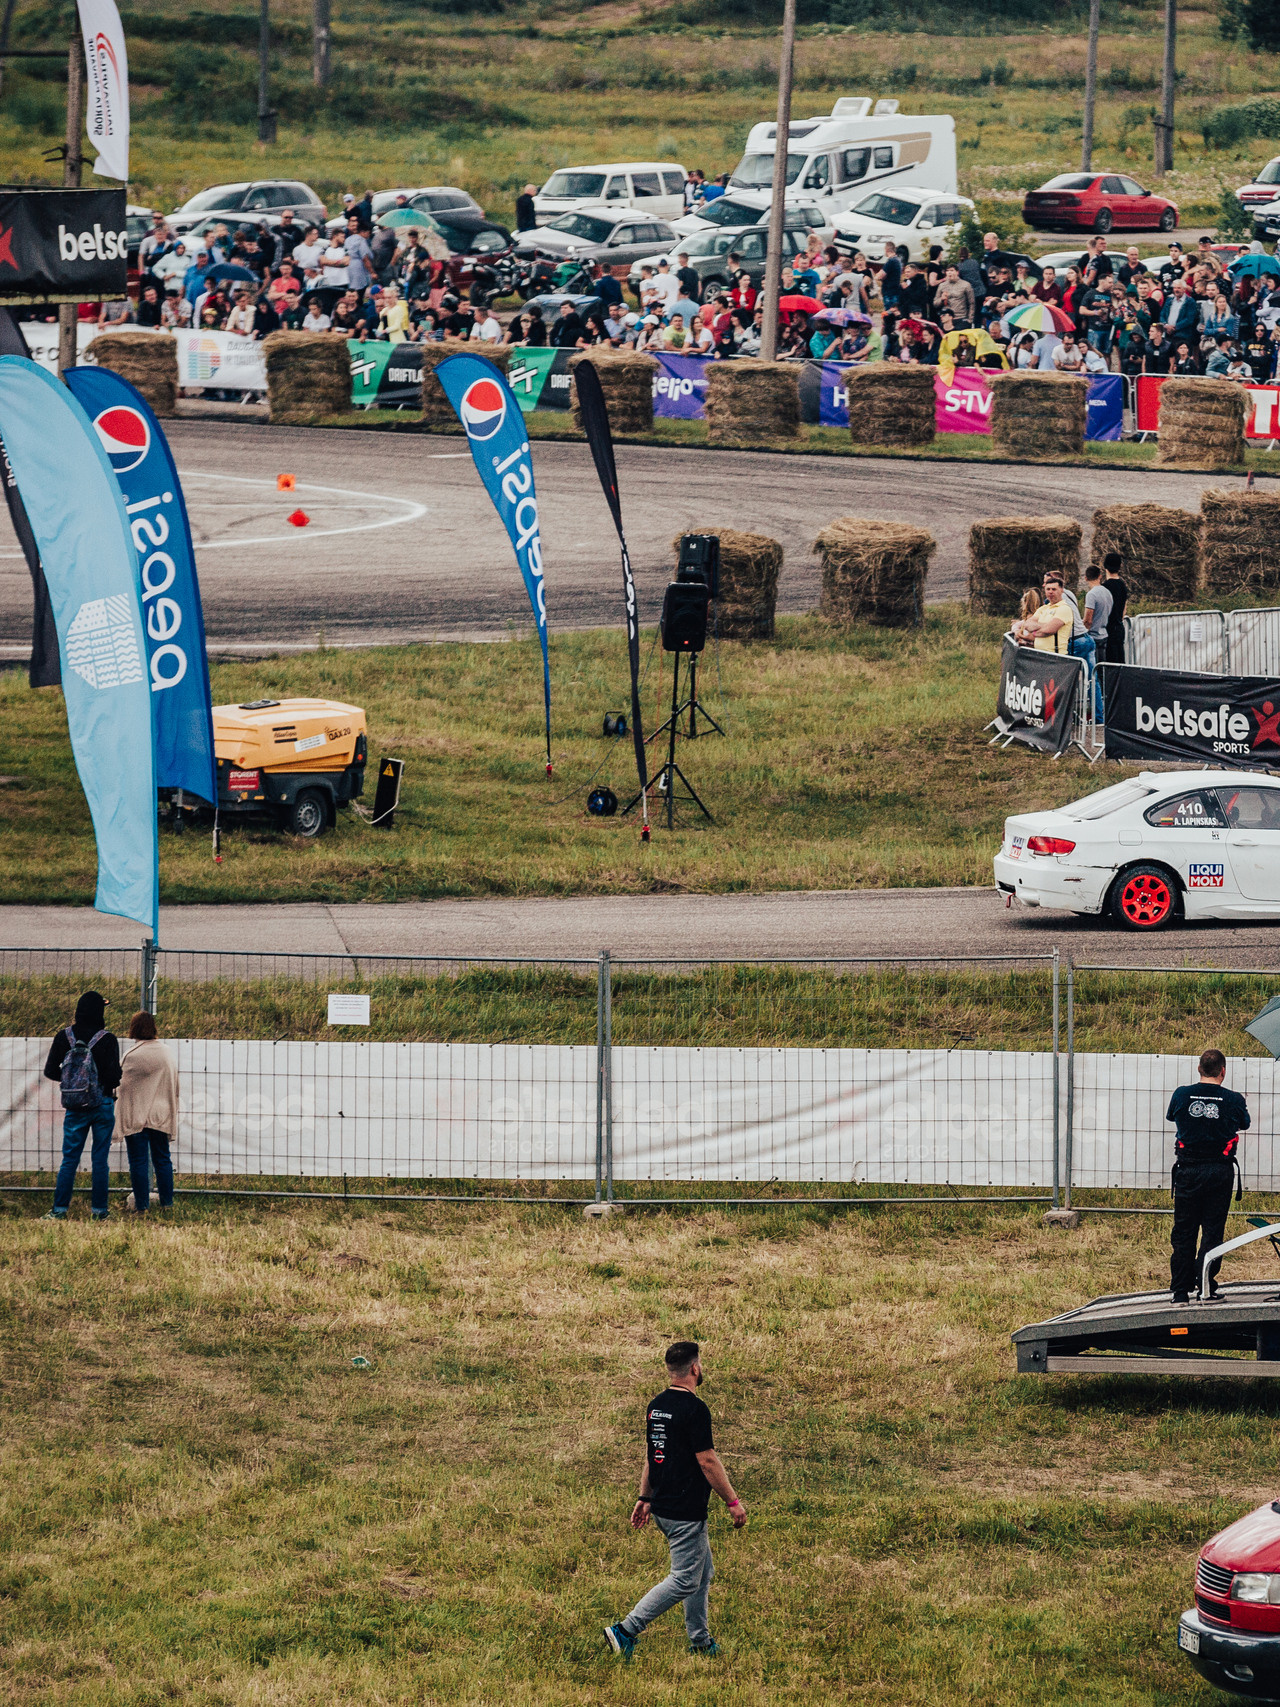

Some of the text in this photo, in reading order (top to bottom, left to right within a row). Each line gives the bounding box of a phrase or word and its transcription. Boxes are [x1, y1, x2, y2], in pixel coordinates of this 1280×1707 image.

[1003, 671, 1043, 716] betsafe
[1024, 714, 1045, 729] SPORTS
[1135, 696, 1251, 741] betsafe
[1212, 740, 1251, 755] SPORTS
[1177, 802, 1203, 816] 410
[1181, 816, 1218, 827] LAPINSKAS
[1190, 864, 1223, 876] LIQUI
[1190, 876, 1223, 887] MOLY
